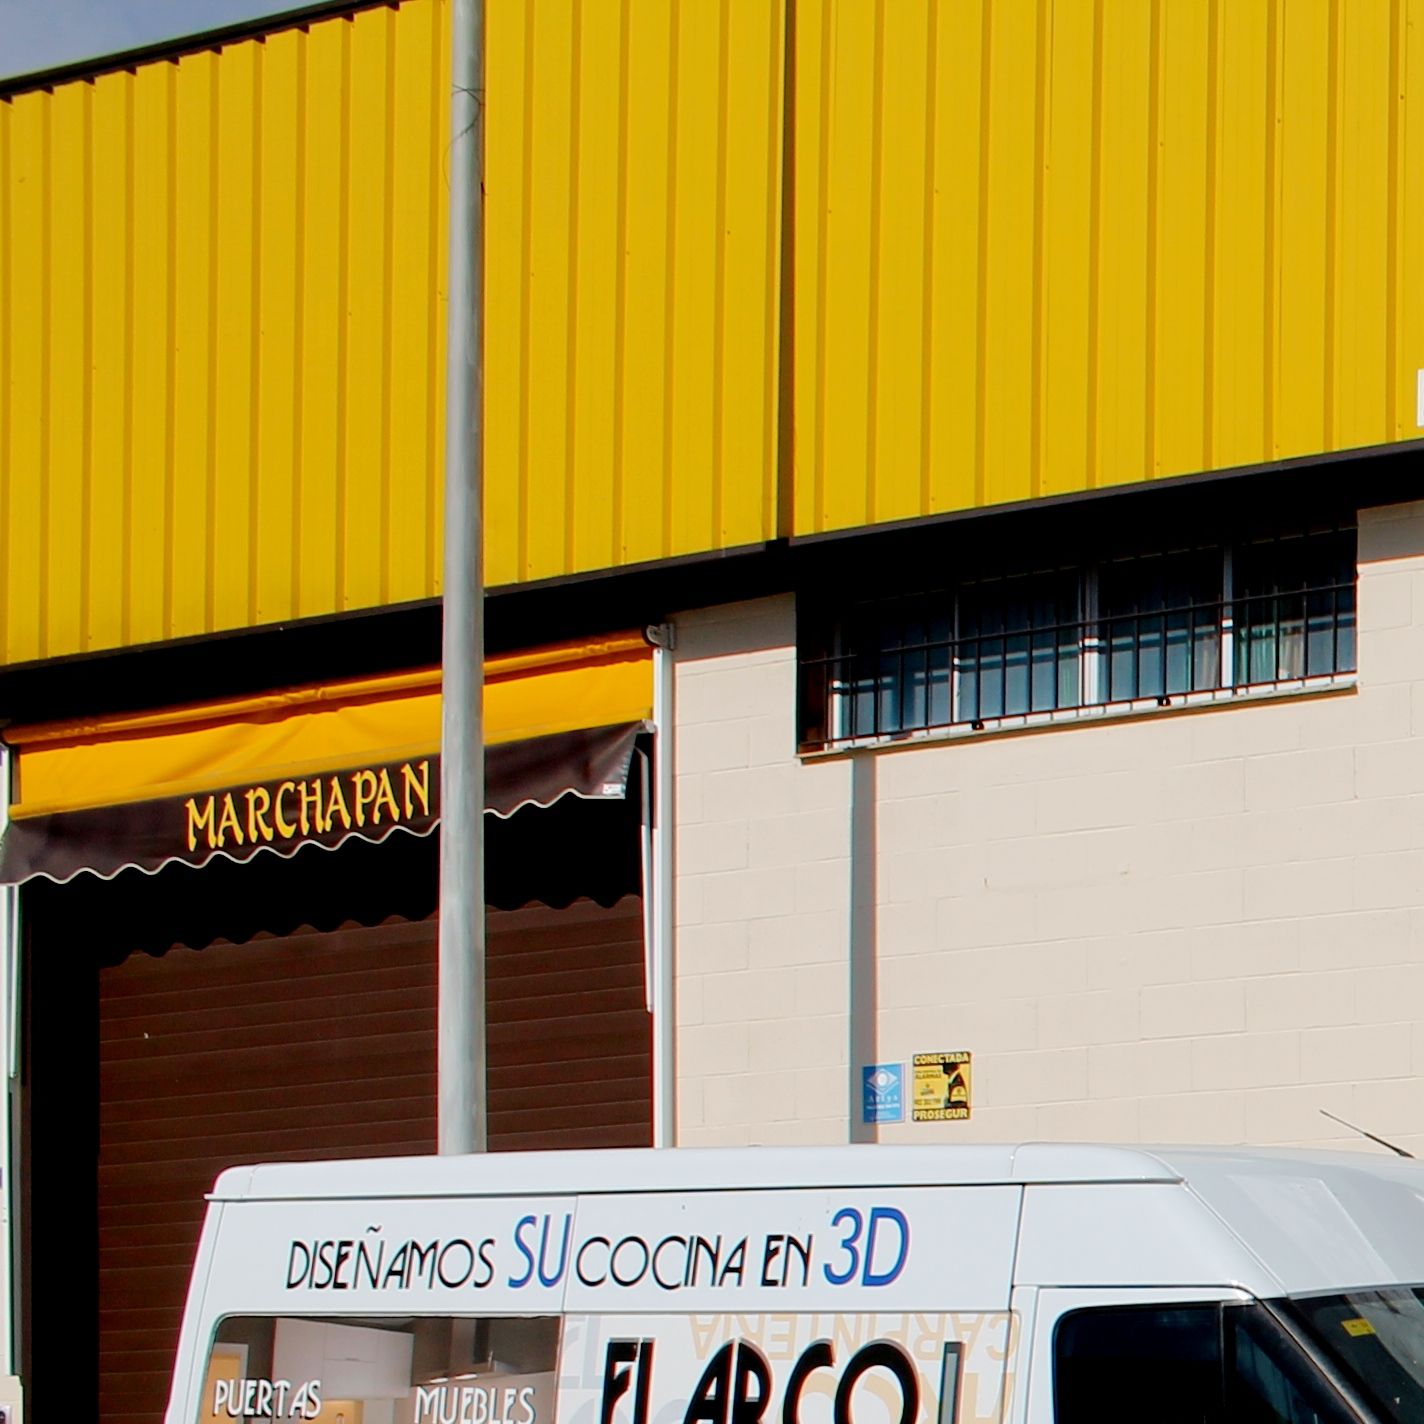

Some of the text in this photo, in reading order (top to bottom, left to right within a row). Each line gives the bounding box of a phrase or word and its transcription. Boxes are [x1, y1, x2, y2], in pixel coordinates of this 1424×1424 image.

[185, 760, 430, 852] MARCHAPAN
[914, 1052, 969, 1065] CONECTADA
[913, 1108, 968, 1120] PROSEGUR
[286, 1207, 911, 1290] DISEÑAMOS SU COCINA EN 3D
[212, 1379, 322, 1419] PUERTAS
